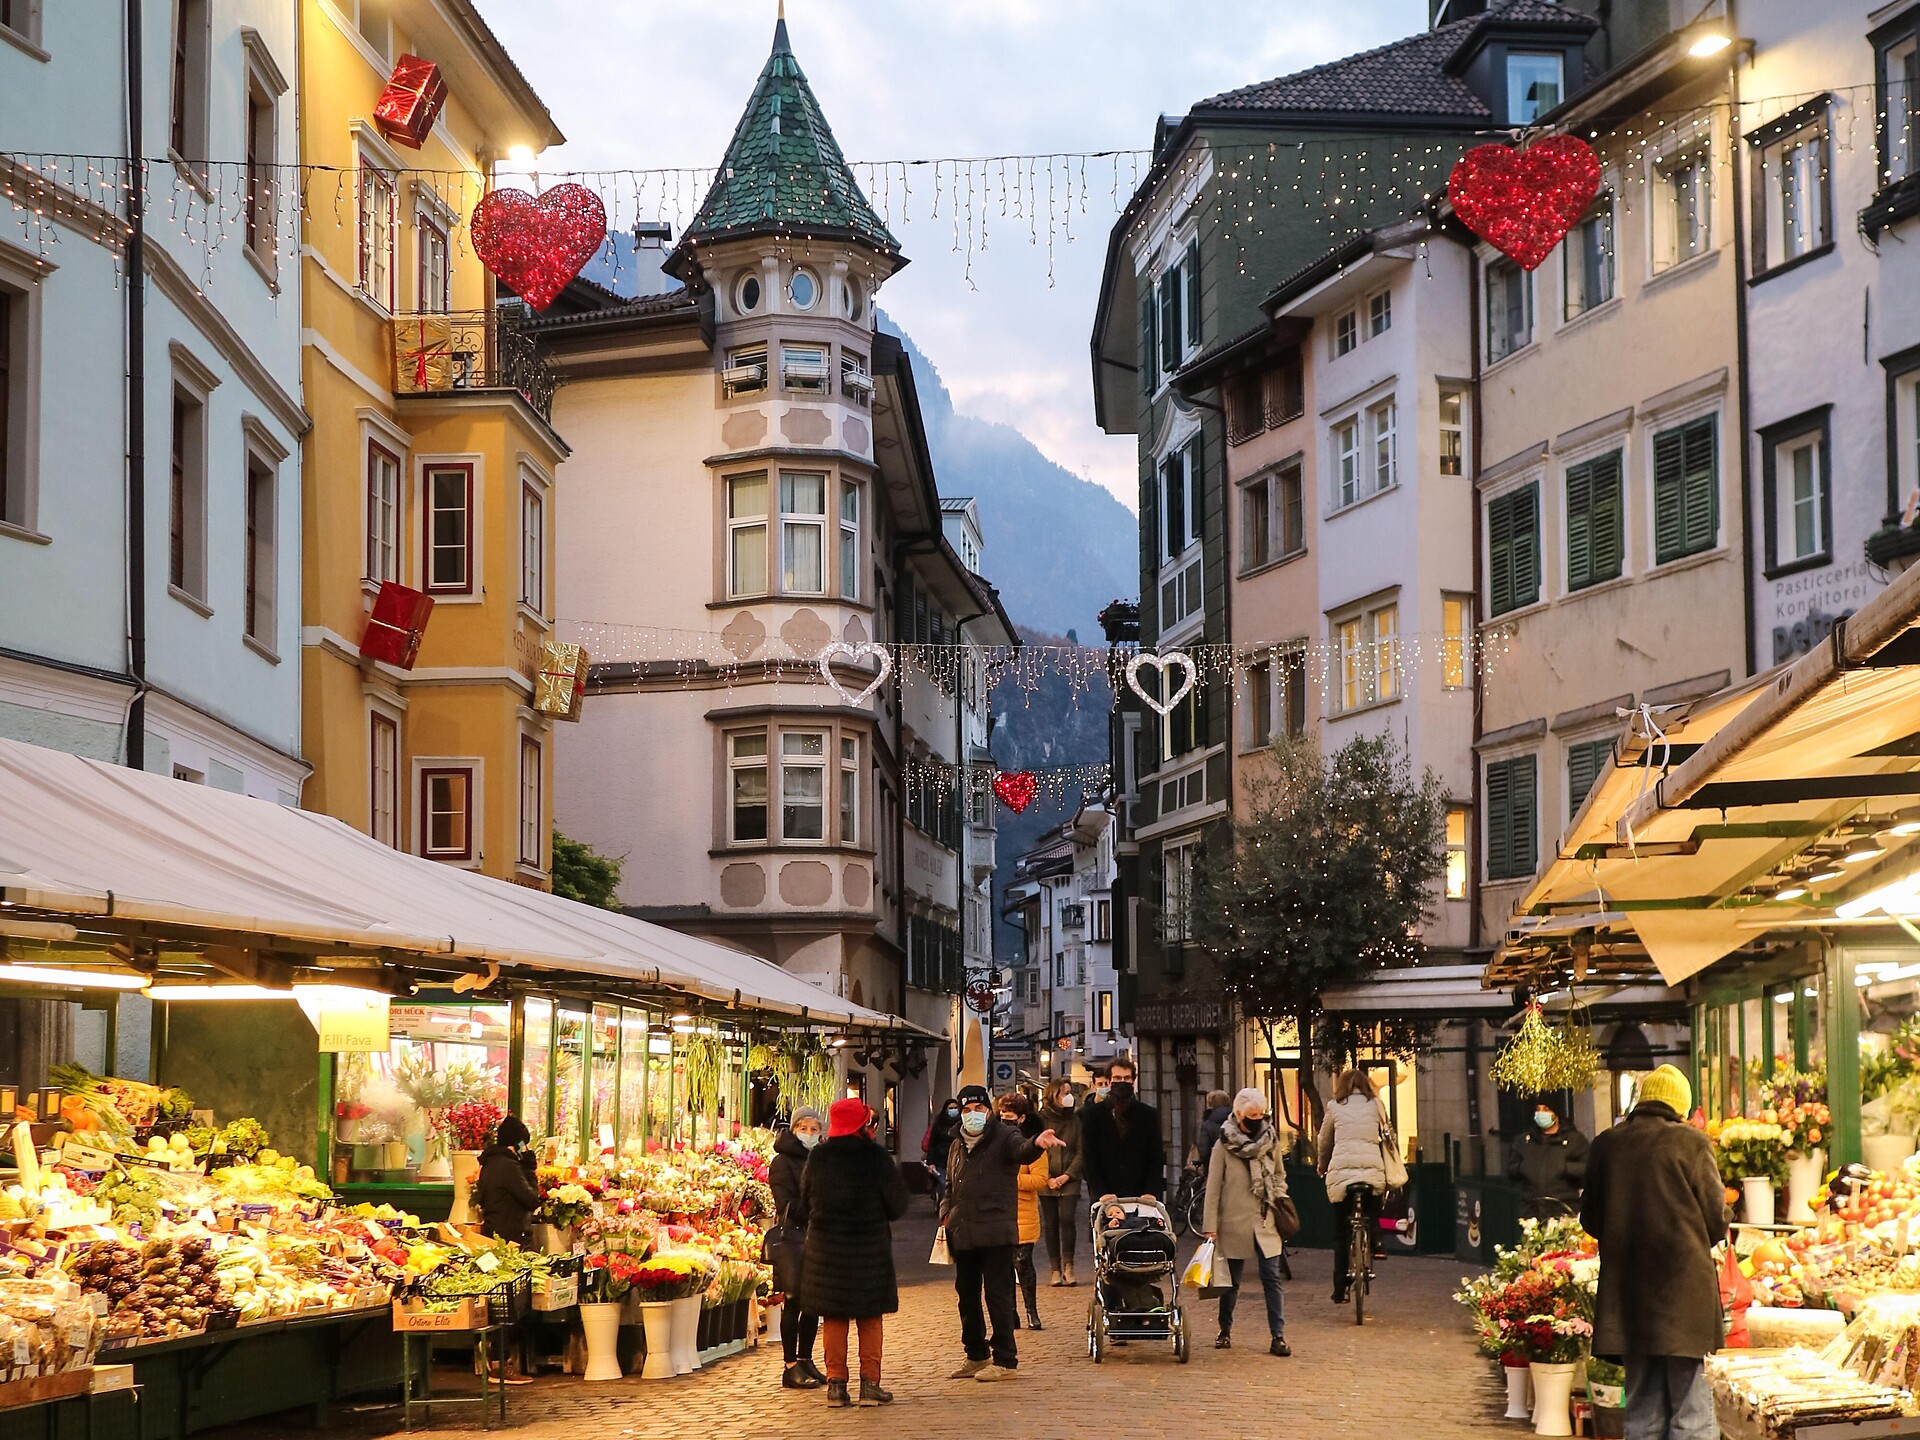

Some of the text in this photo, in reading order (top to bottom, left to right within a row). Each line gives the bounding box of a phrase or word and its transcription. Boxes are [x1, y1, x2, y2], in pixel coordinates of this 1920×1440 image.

[1776, 561, 1867, 598] Pasticceria
[1776, 579, 1867, 618] Konditorei
[1772, 606, 1857, 667] pete
[346, 1034, 372, 1046] Fava
